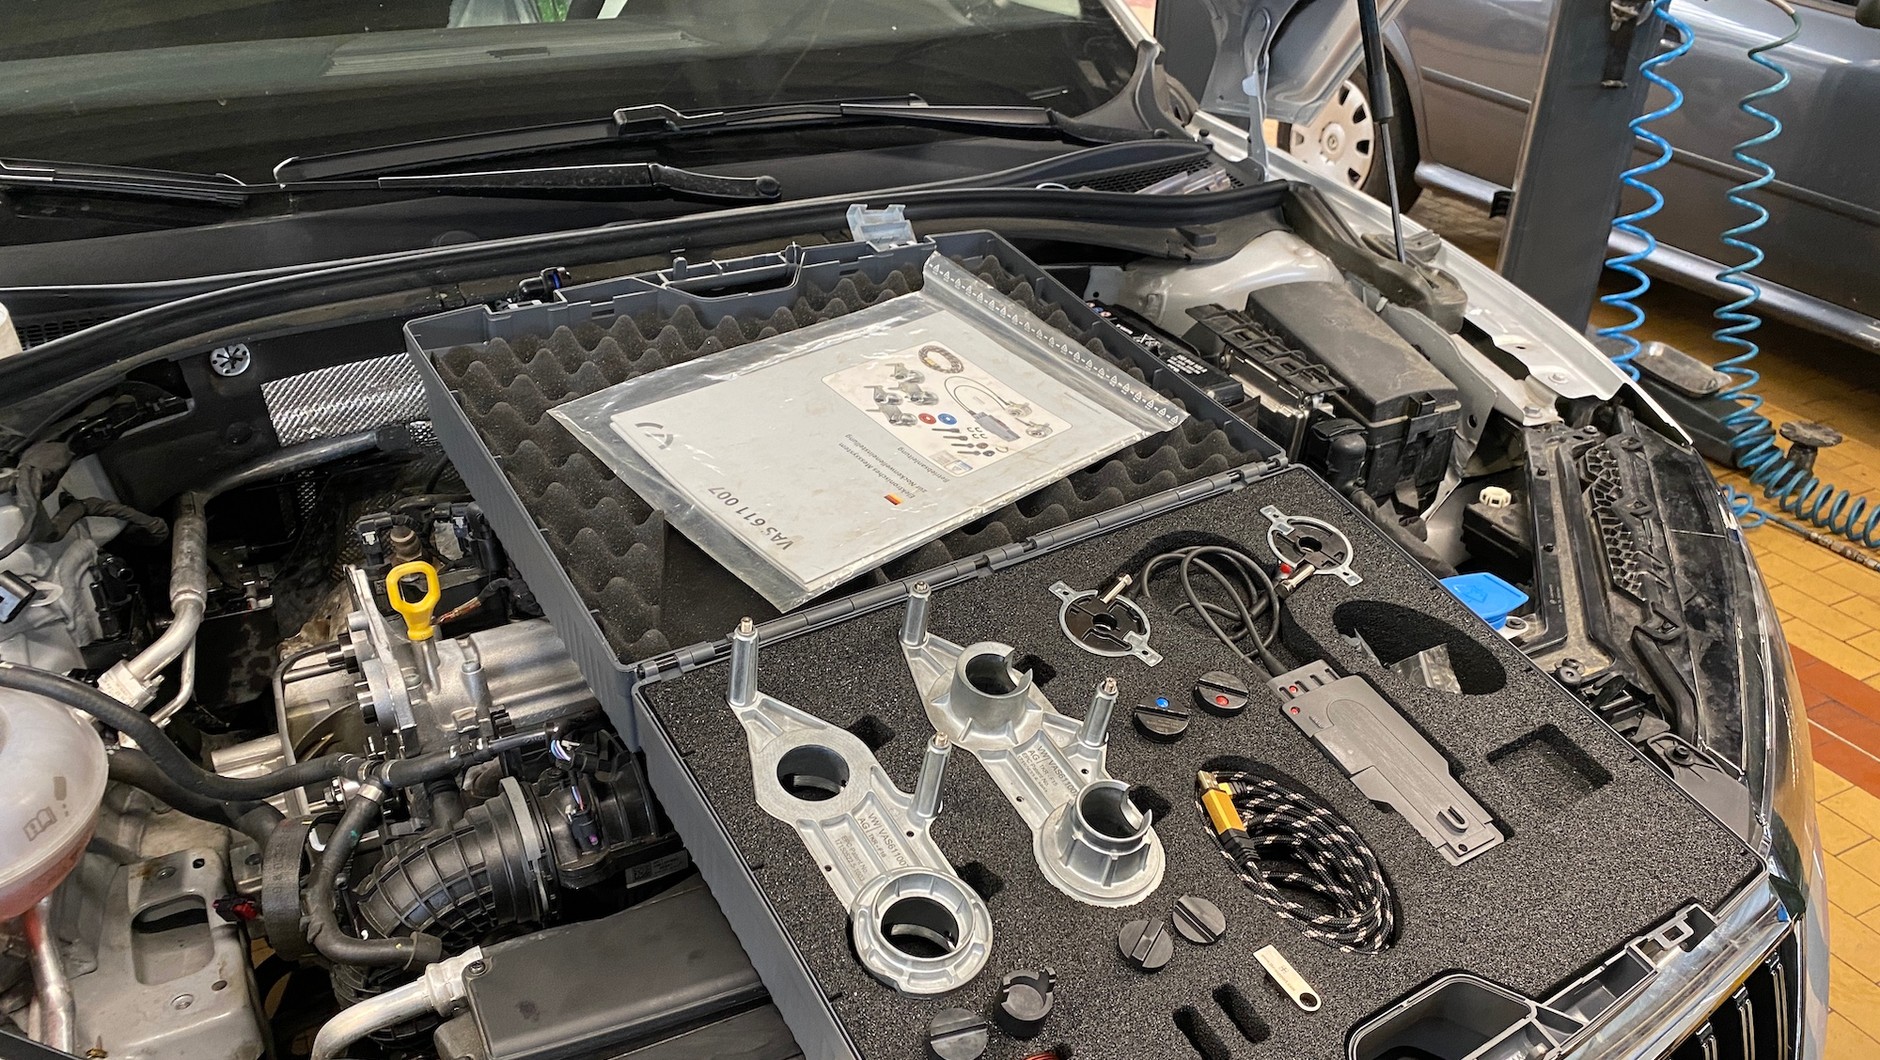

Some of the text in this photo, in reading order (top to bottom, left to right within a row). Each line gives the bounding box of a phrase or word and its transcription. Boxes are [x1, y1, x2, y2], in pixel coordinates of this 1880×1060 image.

[838, 442, 916, 499] Elektronisches Messsystem
[844, 433, 918, 489] Nockenwelleneinstellung
[707, 487, 794, 551] VAS 611 007
[1028, 749, 1040, 761] AG
[858, 817, 870, 830] AG
